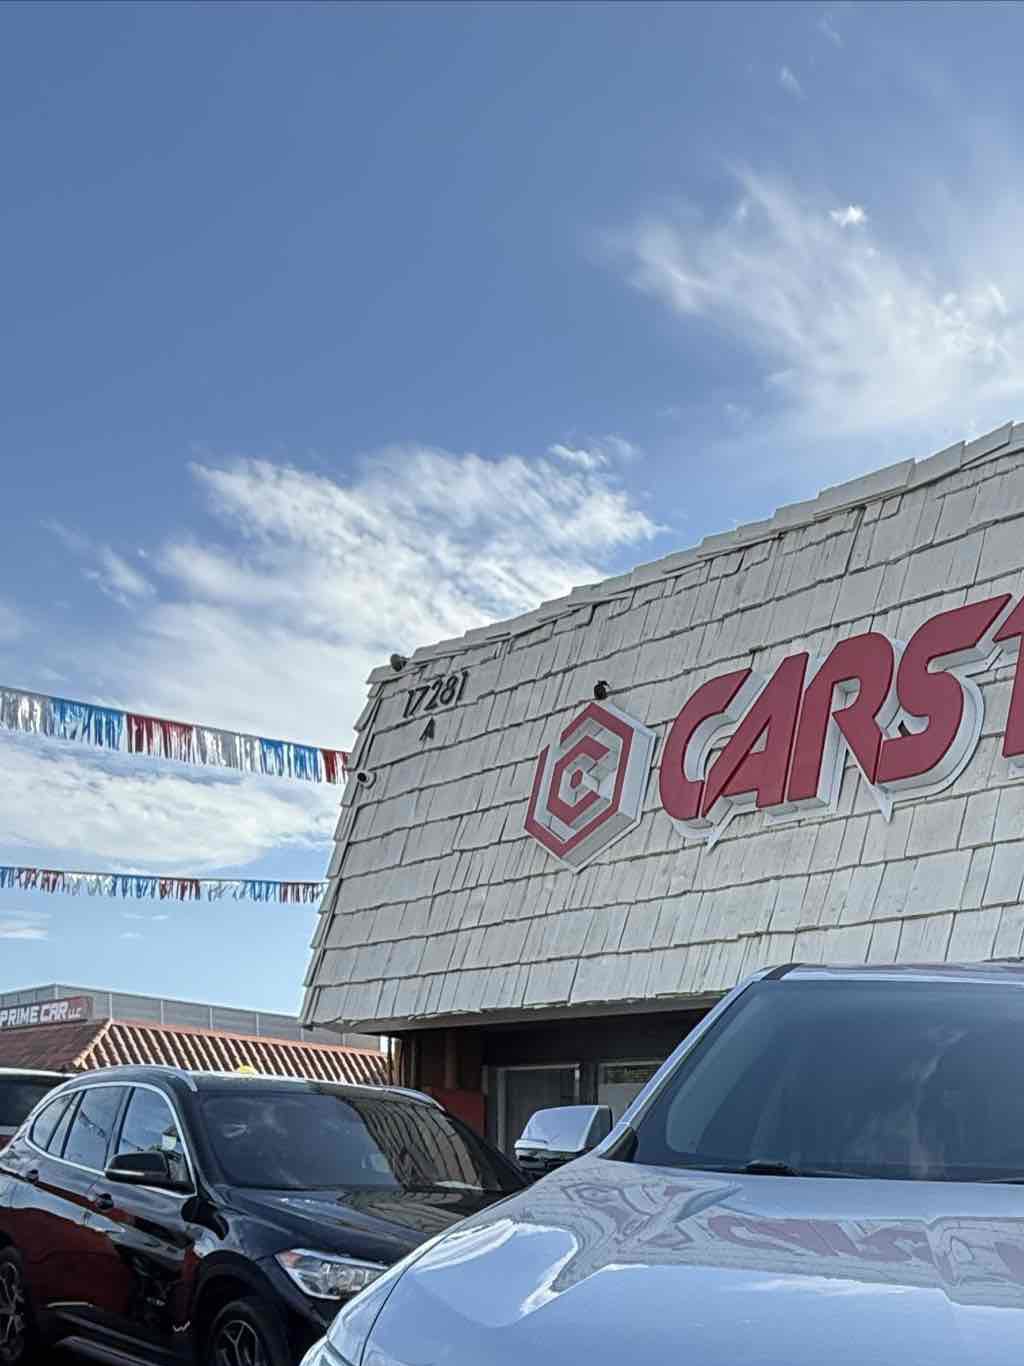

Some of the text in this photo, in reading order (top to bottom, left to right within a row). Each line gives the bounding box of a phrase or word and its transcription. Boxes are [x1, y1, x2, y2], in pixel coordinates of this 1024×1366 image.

[402, 671, 469, 718] 17281
[0, 1001, 81, 1026] PRIME CAR LLC
